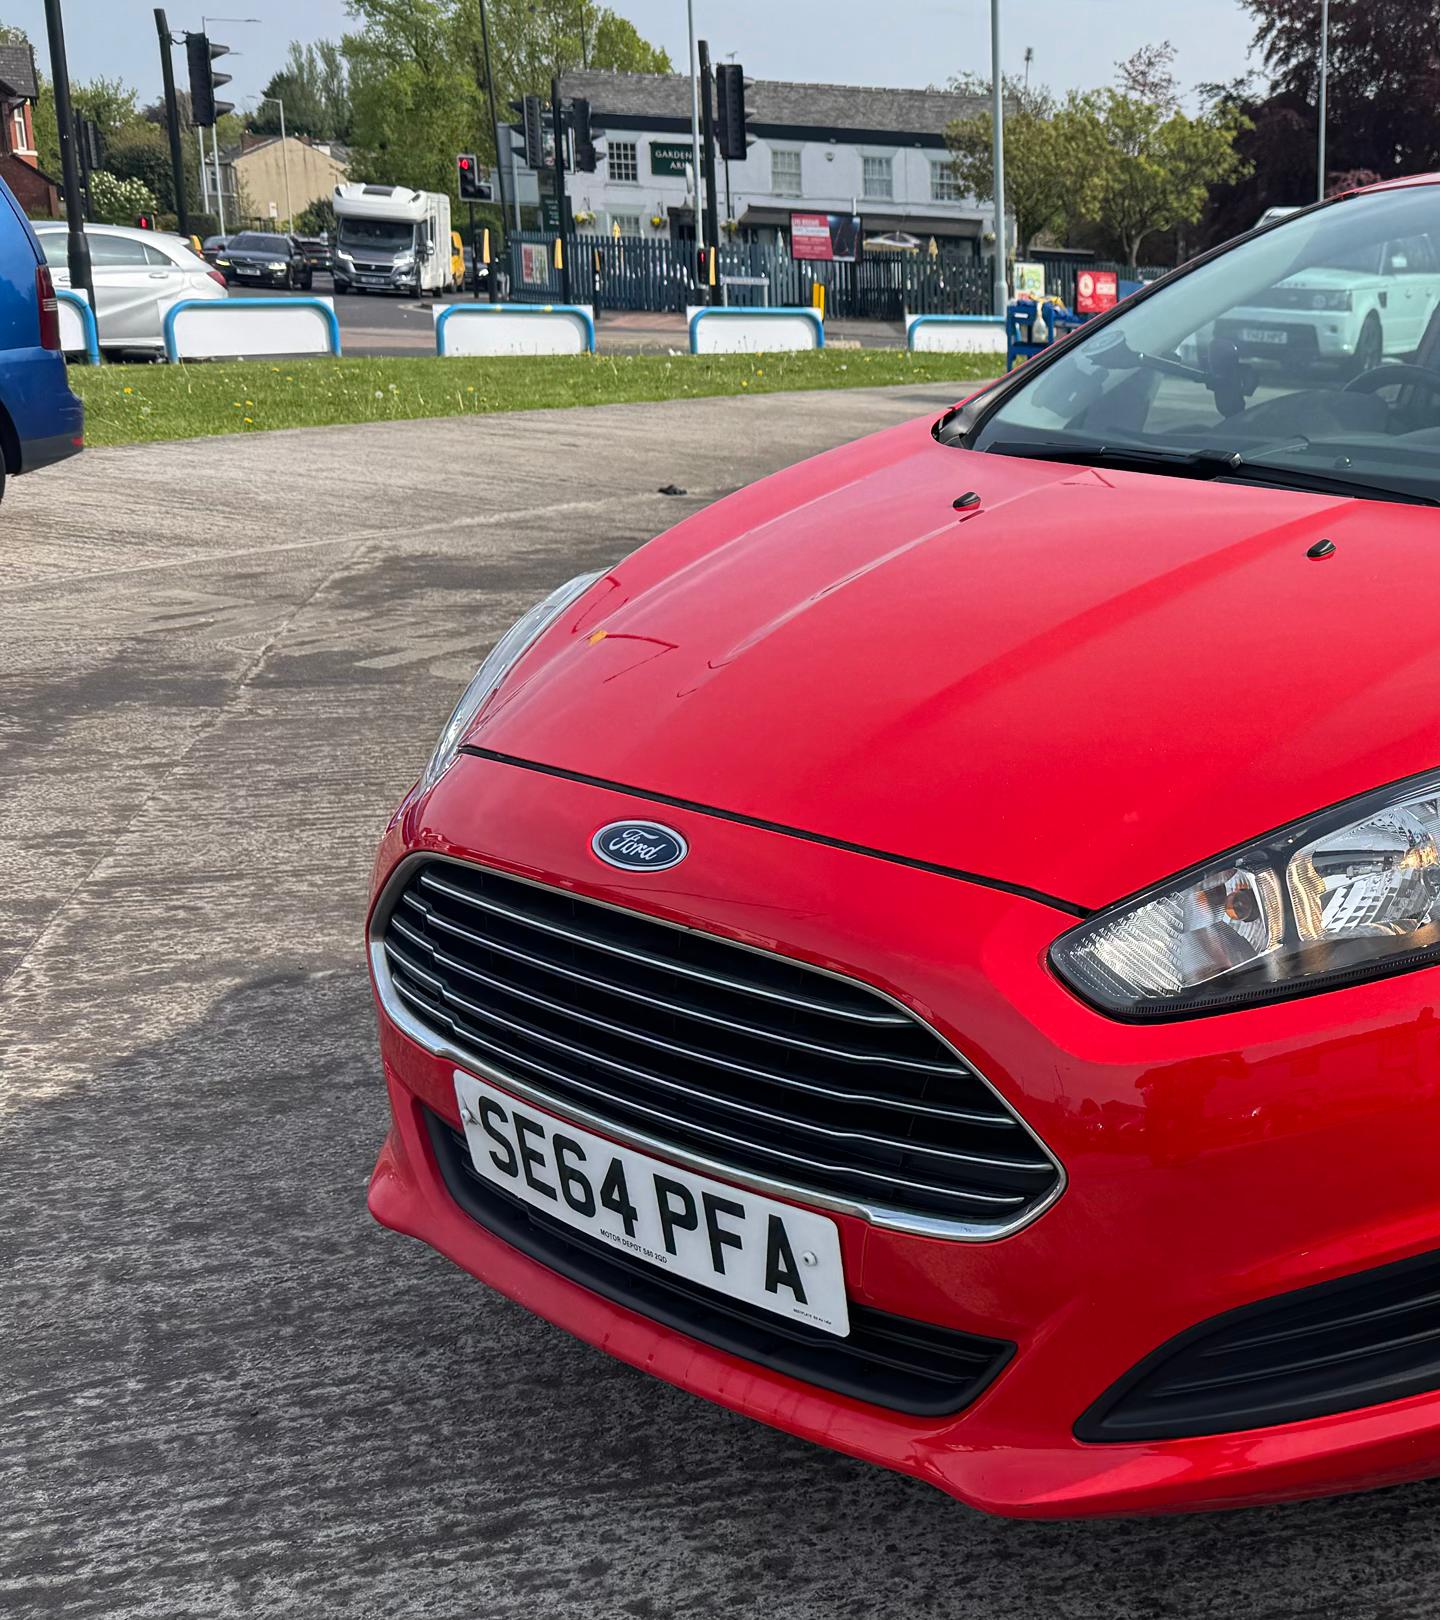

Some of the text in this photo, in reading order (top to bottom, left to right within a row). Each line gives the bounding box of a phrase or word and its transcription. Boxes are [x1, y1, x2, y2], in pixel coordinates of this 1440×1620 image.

[608, 828, 667, 861] Ford
[478, 1095, 809, 1306] SE64 PFA
[600, 1228, 621, 1243] MOTOR
[622, 1238, 642, 1253] DEPOT
